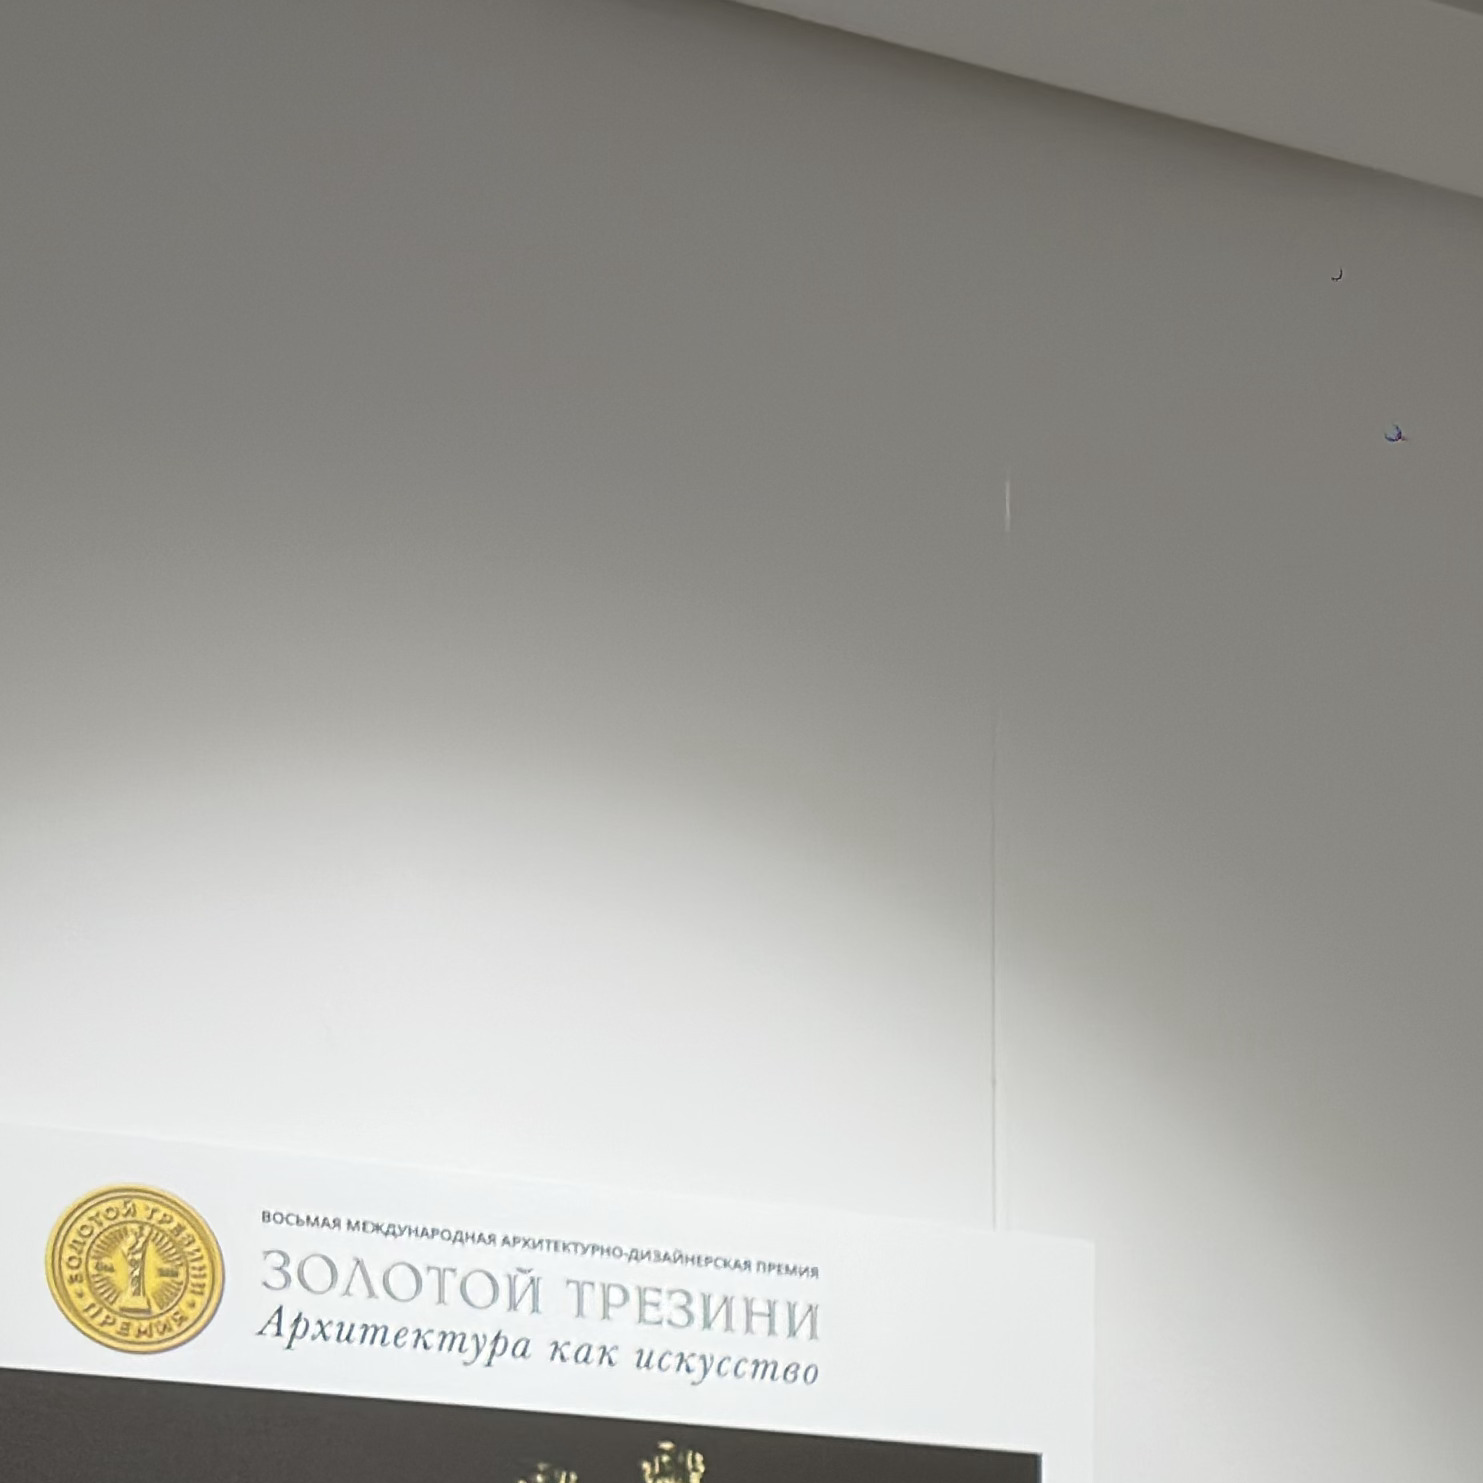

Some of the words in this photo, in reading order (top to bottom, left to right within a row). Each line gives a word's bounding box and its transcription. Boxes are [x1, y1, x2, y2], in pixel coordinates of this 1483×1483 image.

[260, 1210, 342, 1230] ВОСЬМАЯ
[344, 1218, 497, 1246] МЕЖДУНАРОДНАЯ
[500, 1234, 752, 1272] АРХИТЕКТУРНО-ДИЗАЙНЕРСКАЯ
[754, 1260, 820, 1278] ПРЕМИЯ
[261, 1247, 541, 1316] ЗОЛОТОЙ
[565, 1276, 820, 1342] ТРЕЗИНИ
[256, 1304, 532, 1368] Архитектура
[549, 1339, 618, 1367] как
[634, 1346, 819, 1387] искусство
